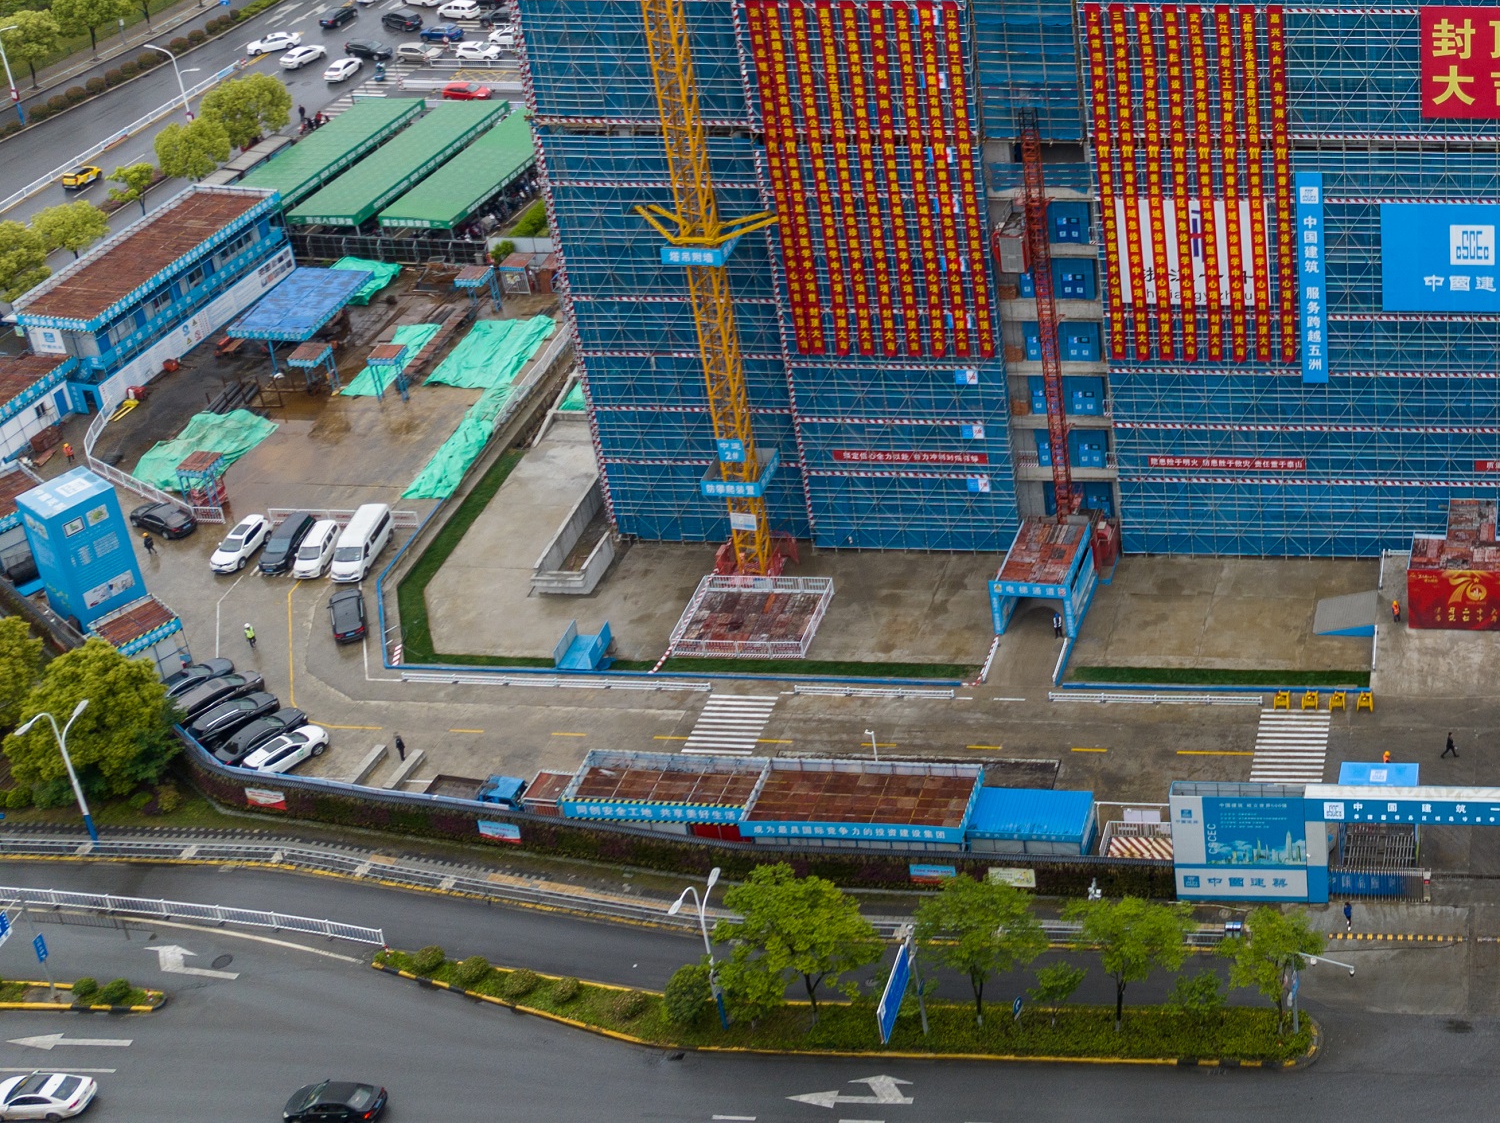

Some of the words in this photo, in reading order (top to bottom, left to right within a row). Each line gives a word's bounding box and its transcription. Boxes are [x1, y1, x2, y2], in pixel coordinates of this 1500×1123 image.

[1302, 215, 1320, 274] 中国建筑
[669, 251, 714, 264] 塔吊附墙
[1306, 286, 1323, 371] 服务跨越五洲
[1005, 585, 1056, 597] 电梯通道
[575, 804, 653, 819] 同创安全工地
[660, 808, 737, 822] 共享美好生活
[753, 824, 947, 841] 成为最具国际竞争力的投资建设集团
[1206, 823, 1217, 855] CSCEC
